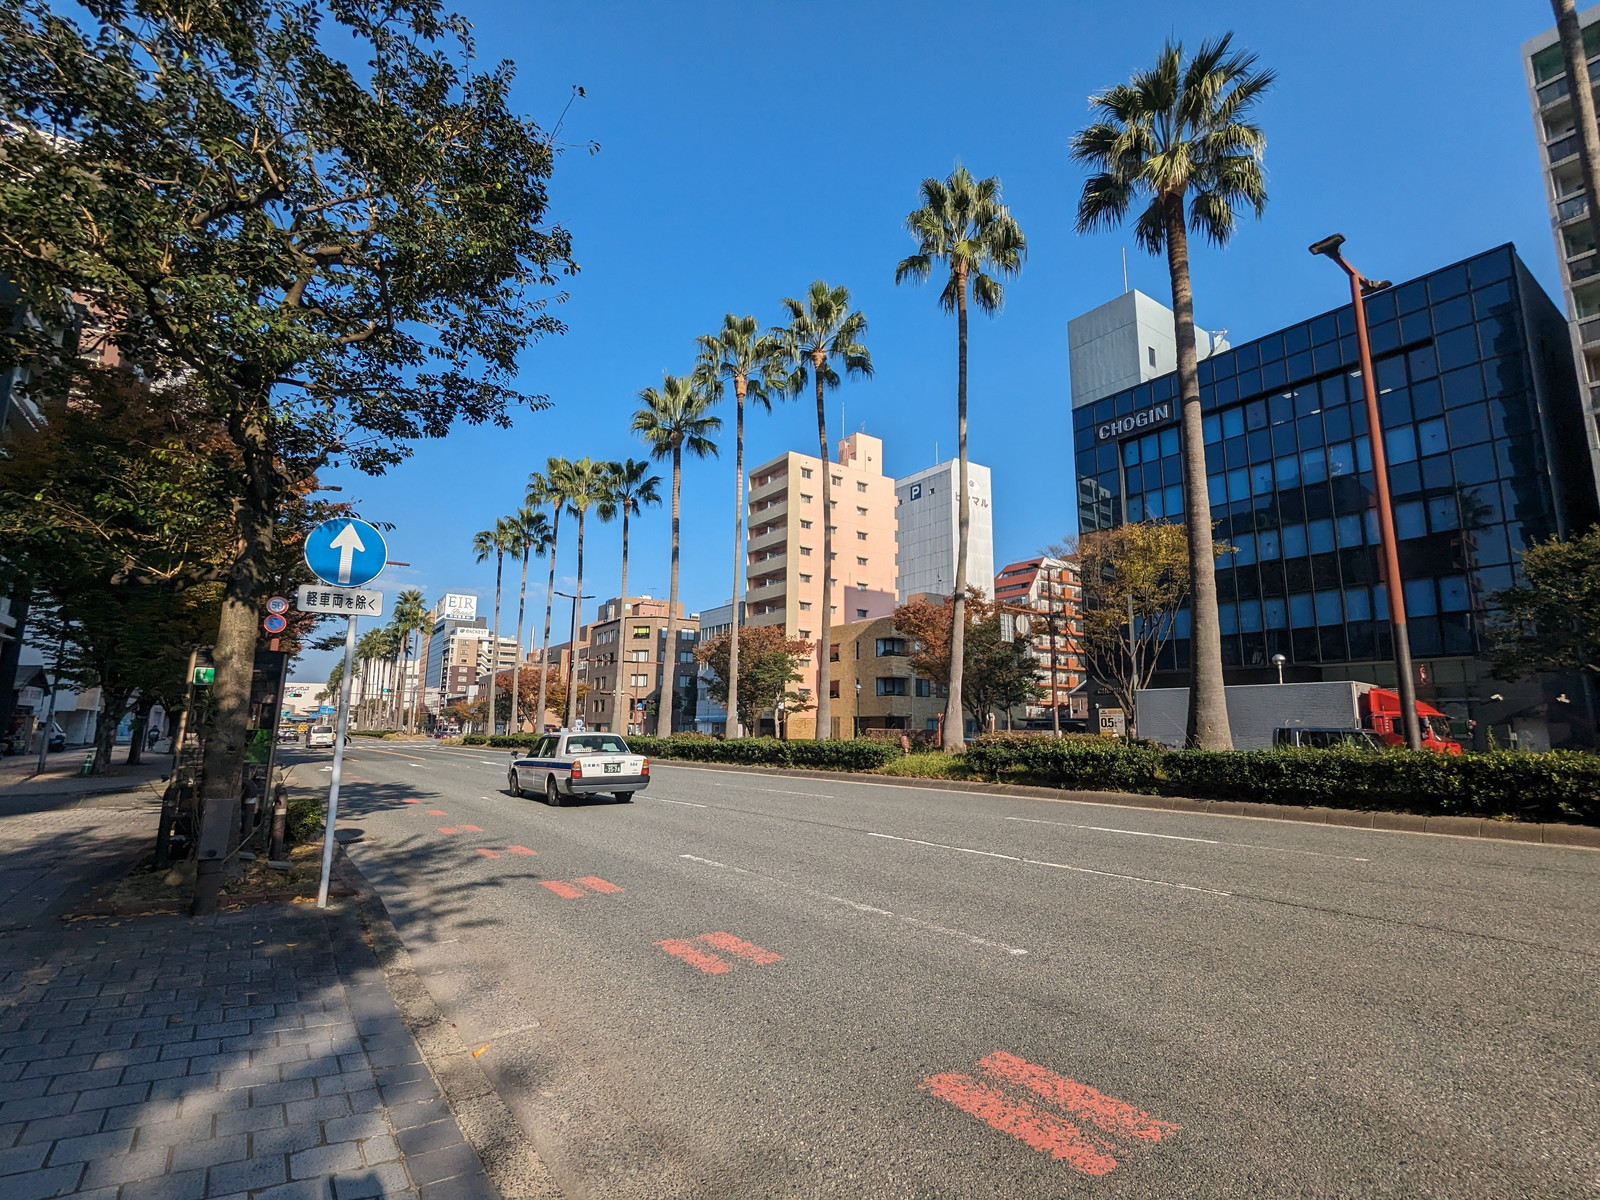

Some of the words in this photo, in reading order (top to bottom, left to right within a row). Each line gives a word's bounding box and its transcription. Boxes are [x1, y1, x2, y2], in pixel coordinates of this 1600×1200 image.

[1098, 404, 1168, 439] CHOGIN
[912, 486, 920, 499] P
[271, 601, 283, 609] 50
[305, 590, 376, 611] 軽車両を除く
[448, 595, 475, 610] EIR
